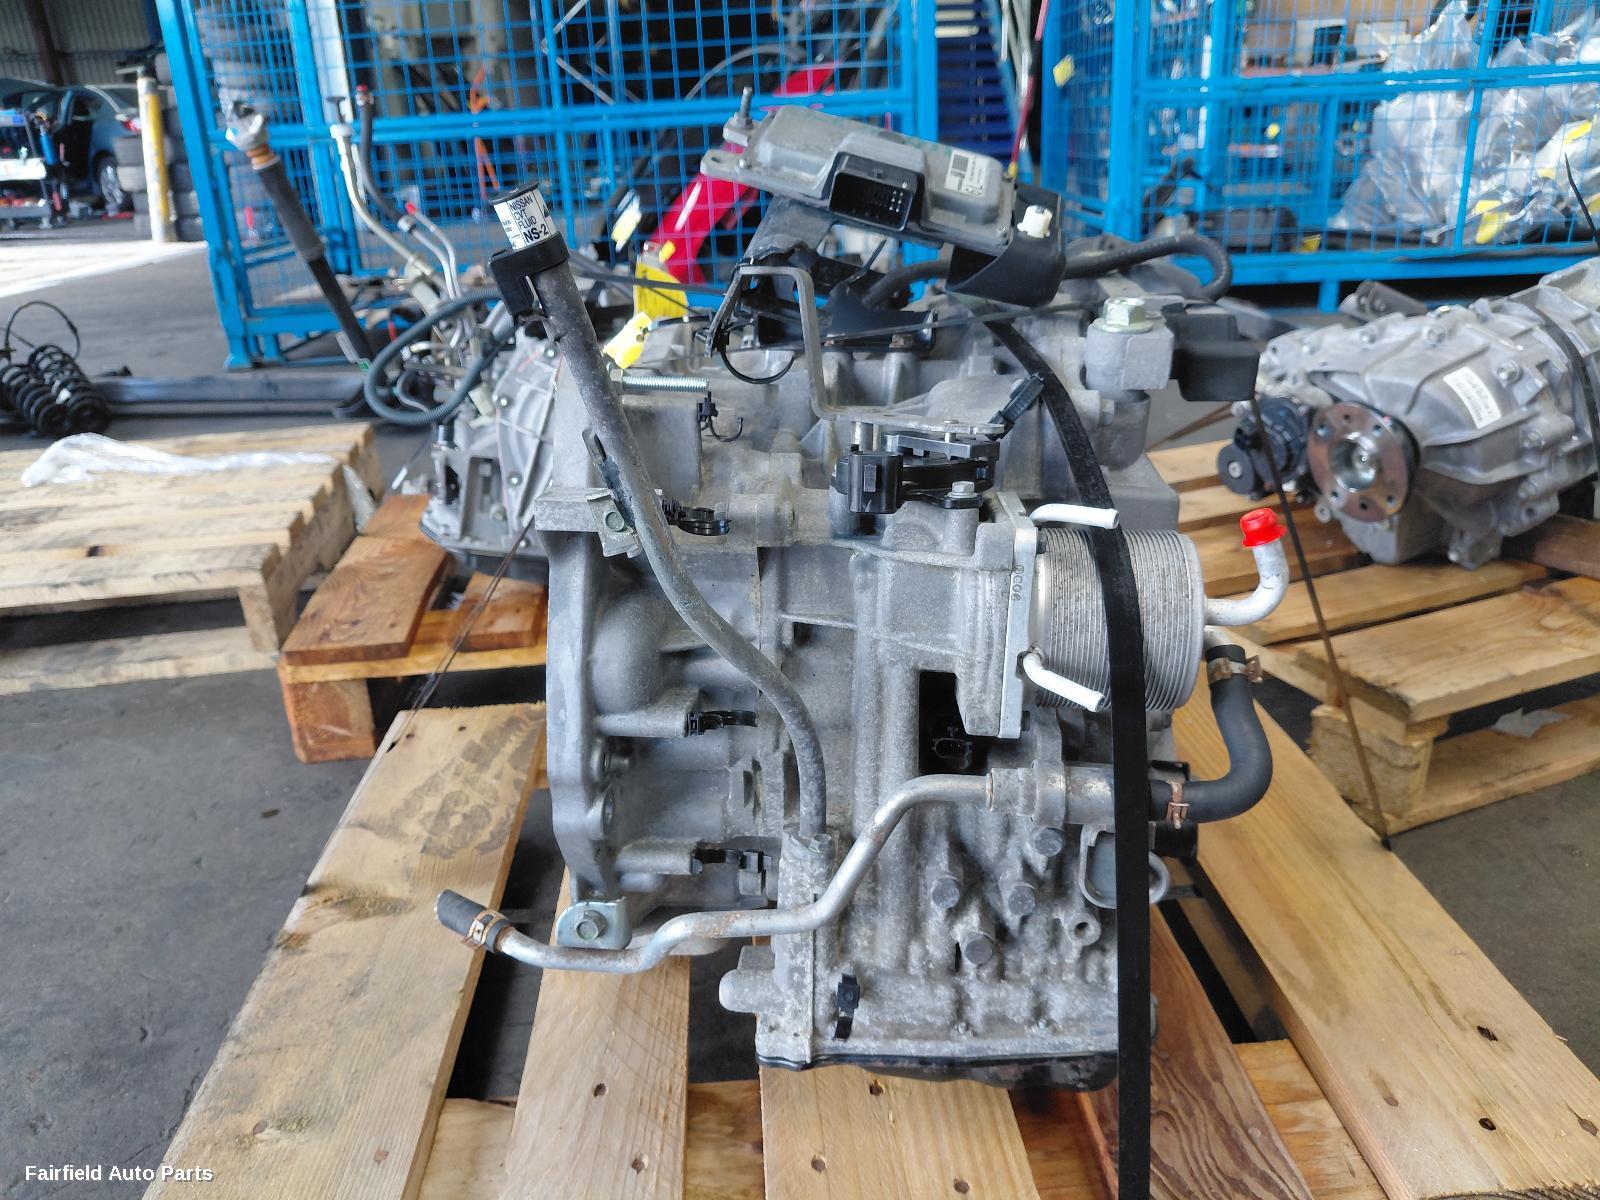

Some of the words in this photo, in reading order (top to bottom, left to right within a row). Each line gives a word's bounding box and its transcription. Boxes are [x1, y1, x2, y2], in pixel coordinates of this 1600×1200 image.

[509, 194, 533, 211] NISSAN
[513, 208, 528, 221] CVT
[517, 215, 537, 230] FLUID
[523, 223, 549, 243] NS-2
